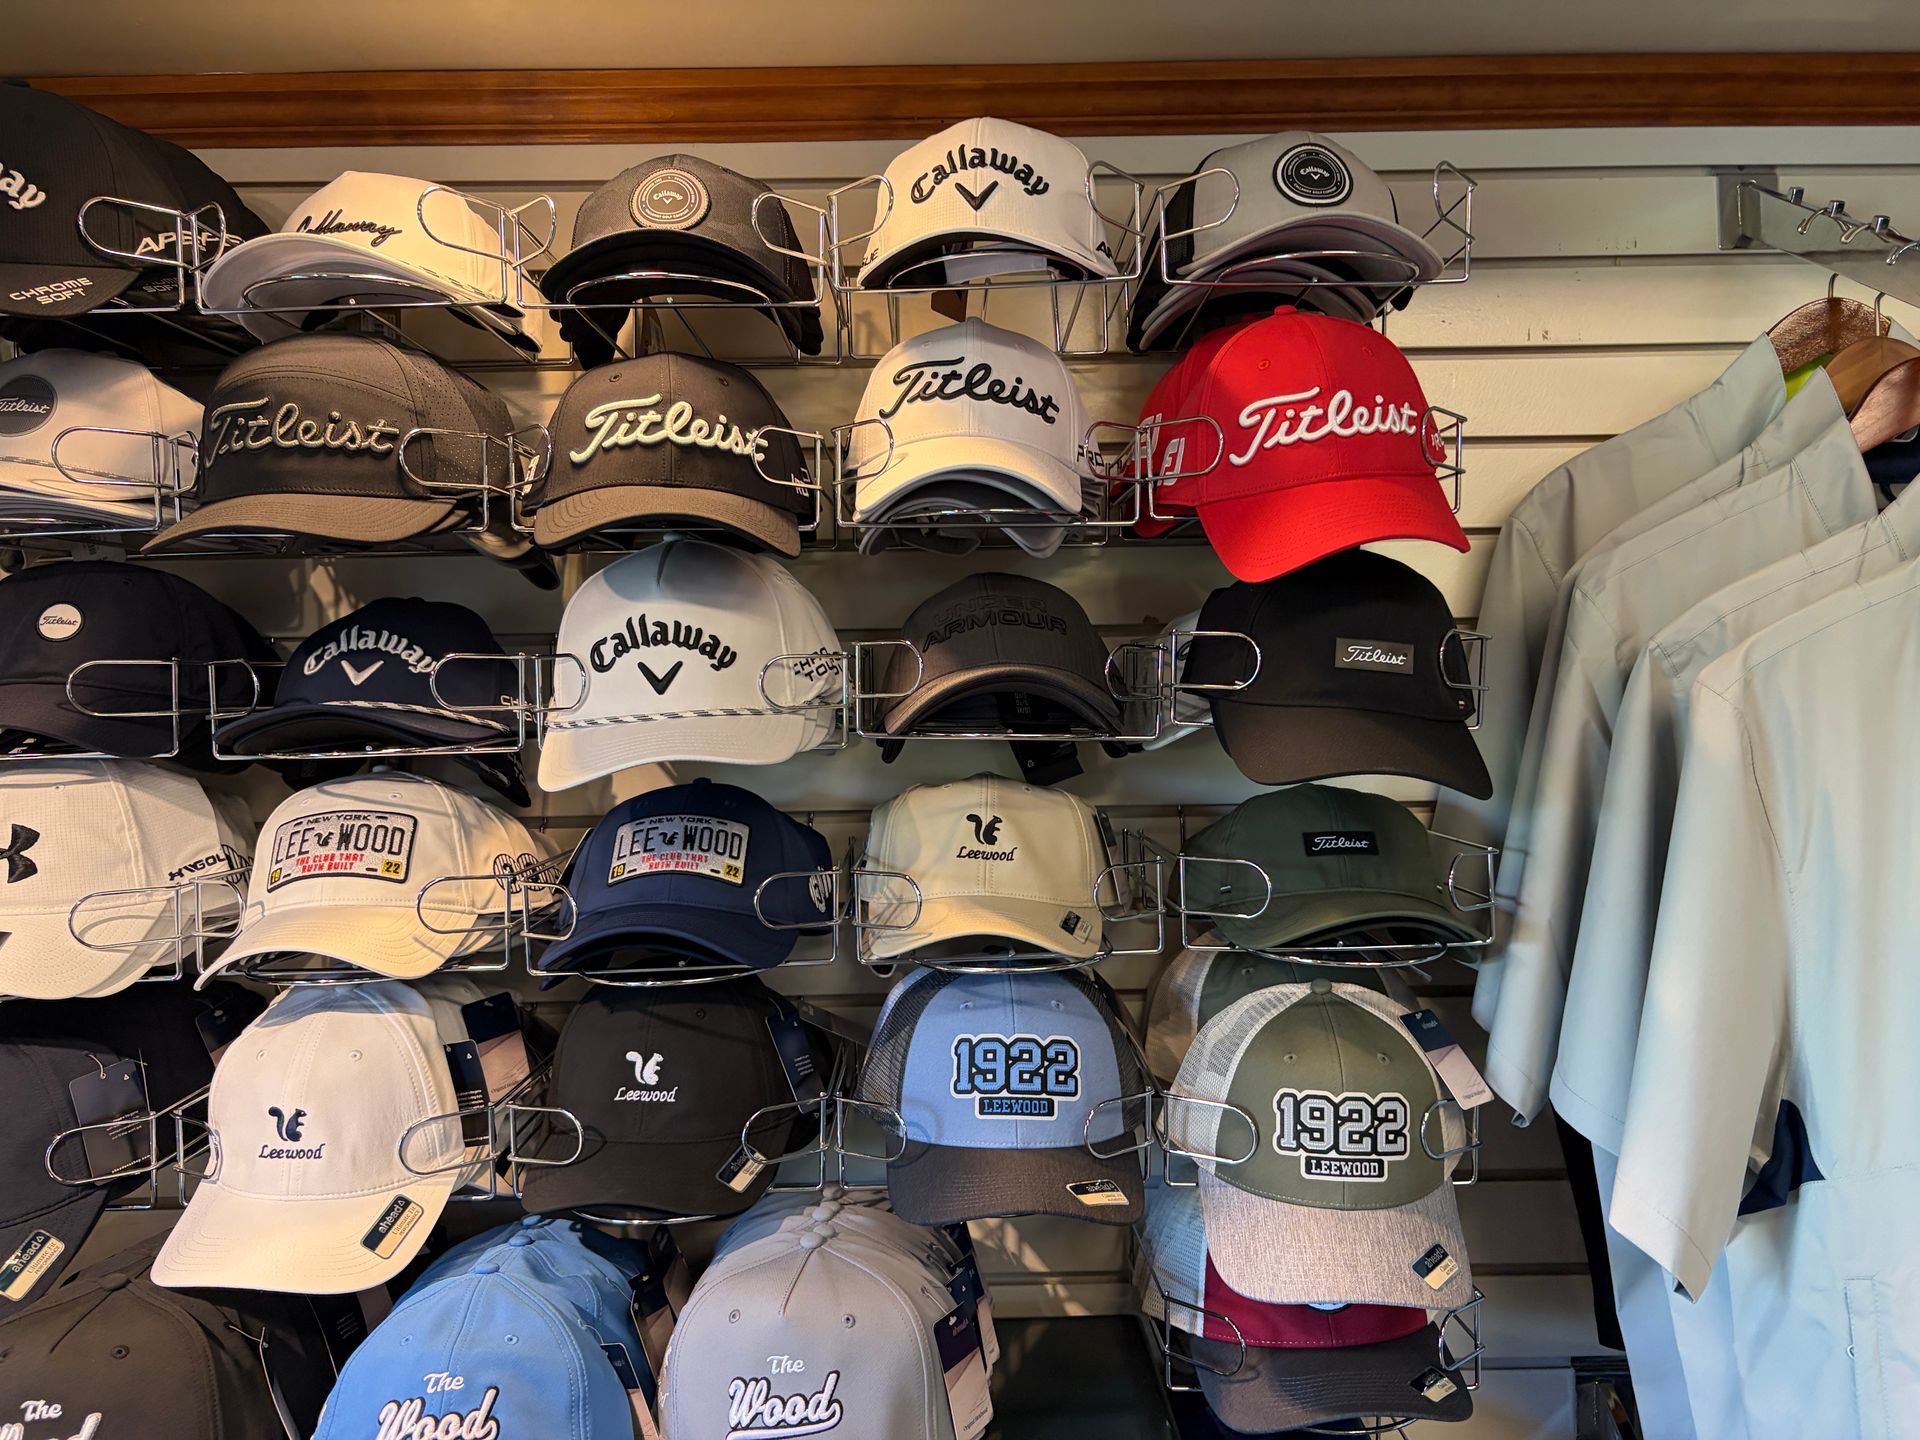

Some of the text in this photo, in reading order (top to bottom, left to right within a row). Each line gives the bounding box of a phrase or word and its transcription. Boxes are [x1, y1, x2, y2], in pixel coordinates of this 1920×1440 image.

[911, 144, 1049, 204] Callaway
[1300, 166, 1330, 178] Callaway
[0, 161, 46, 210] ay
[653, 189, 683, 201] Callaway
[9, 277, 93, 301] CHROME
[36, 287, 86, 305] SOFT
[878, 356, 1060, 424] Titleist
[204, 396, 400, 469] Titleist
[569, 393, 769, 464] Titleist
[1229, 386, 1418, 466] Titleist
[40, 615, 78, 626] Titleist
[934, 594, 1047, 627] UNDER
[922, 609, 1068, 653] ARMOUR
[303, 625, 438, 676] Callaway
[589, 613, 738, 674] Callaway
[1343, 645, 1407, 665] Titleist
[306, 814, 371, 825] NEW YORK
[649, 816, 713, 825] NEW YORK
[275, 827, 315, 865] LEE
[337, 823, 405, 856] WOOD
[617, 825, 743, 860] LEE WOOD
[956, 846, 1018, 861] Leewood
[1311, 835, 1370, 851] Titleist
[296, 855, 310, 866] THE
[385, 862, 401, 875] 22
[612, 864, 624, 877] 19
[725, 864, 740, 878] 22
[954, 1037, 1079, 1096] 1922
[613, 1086, 679, 1102] Leewood
[983, 1100, 1048, 1114] LEEWOOD
[1277, 1092, 1408, 1156] 1922
[258, 1143, 326, 1159] Leewood
[1311, 1160, 1379, 1176] LEEWOOD
[378, 1204, 403, 1234] ahead
[12, 1241, 41, 1273] ahead
[766, 1355, 805, 1375] The
[423, 1372, 465, 1394] The
[20, 1399, 62, 1422] The
[727, 1370, 843, 1432] Wood
[376, 1386, 500, 1440] Wood
